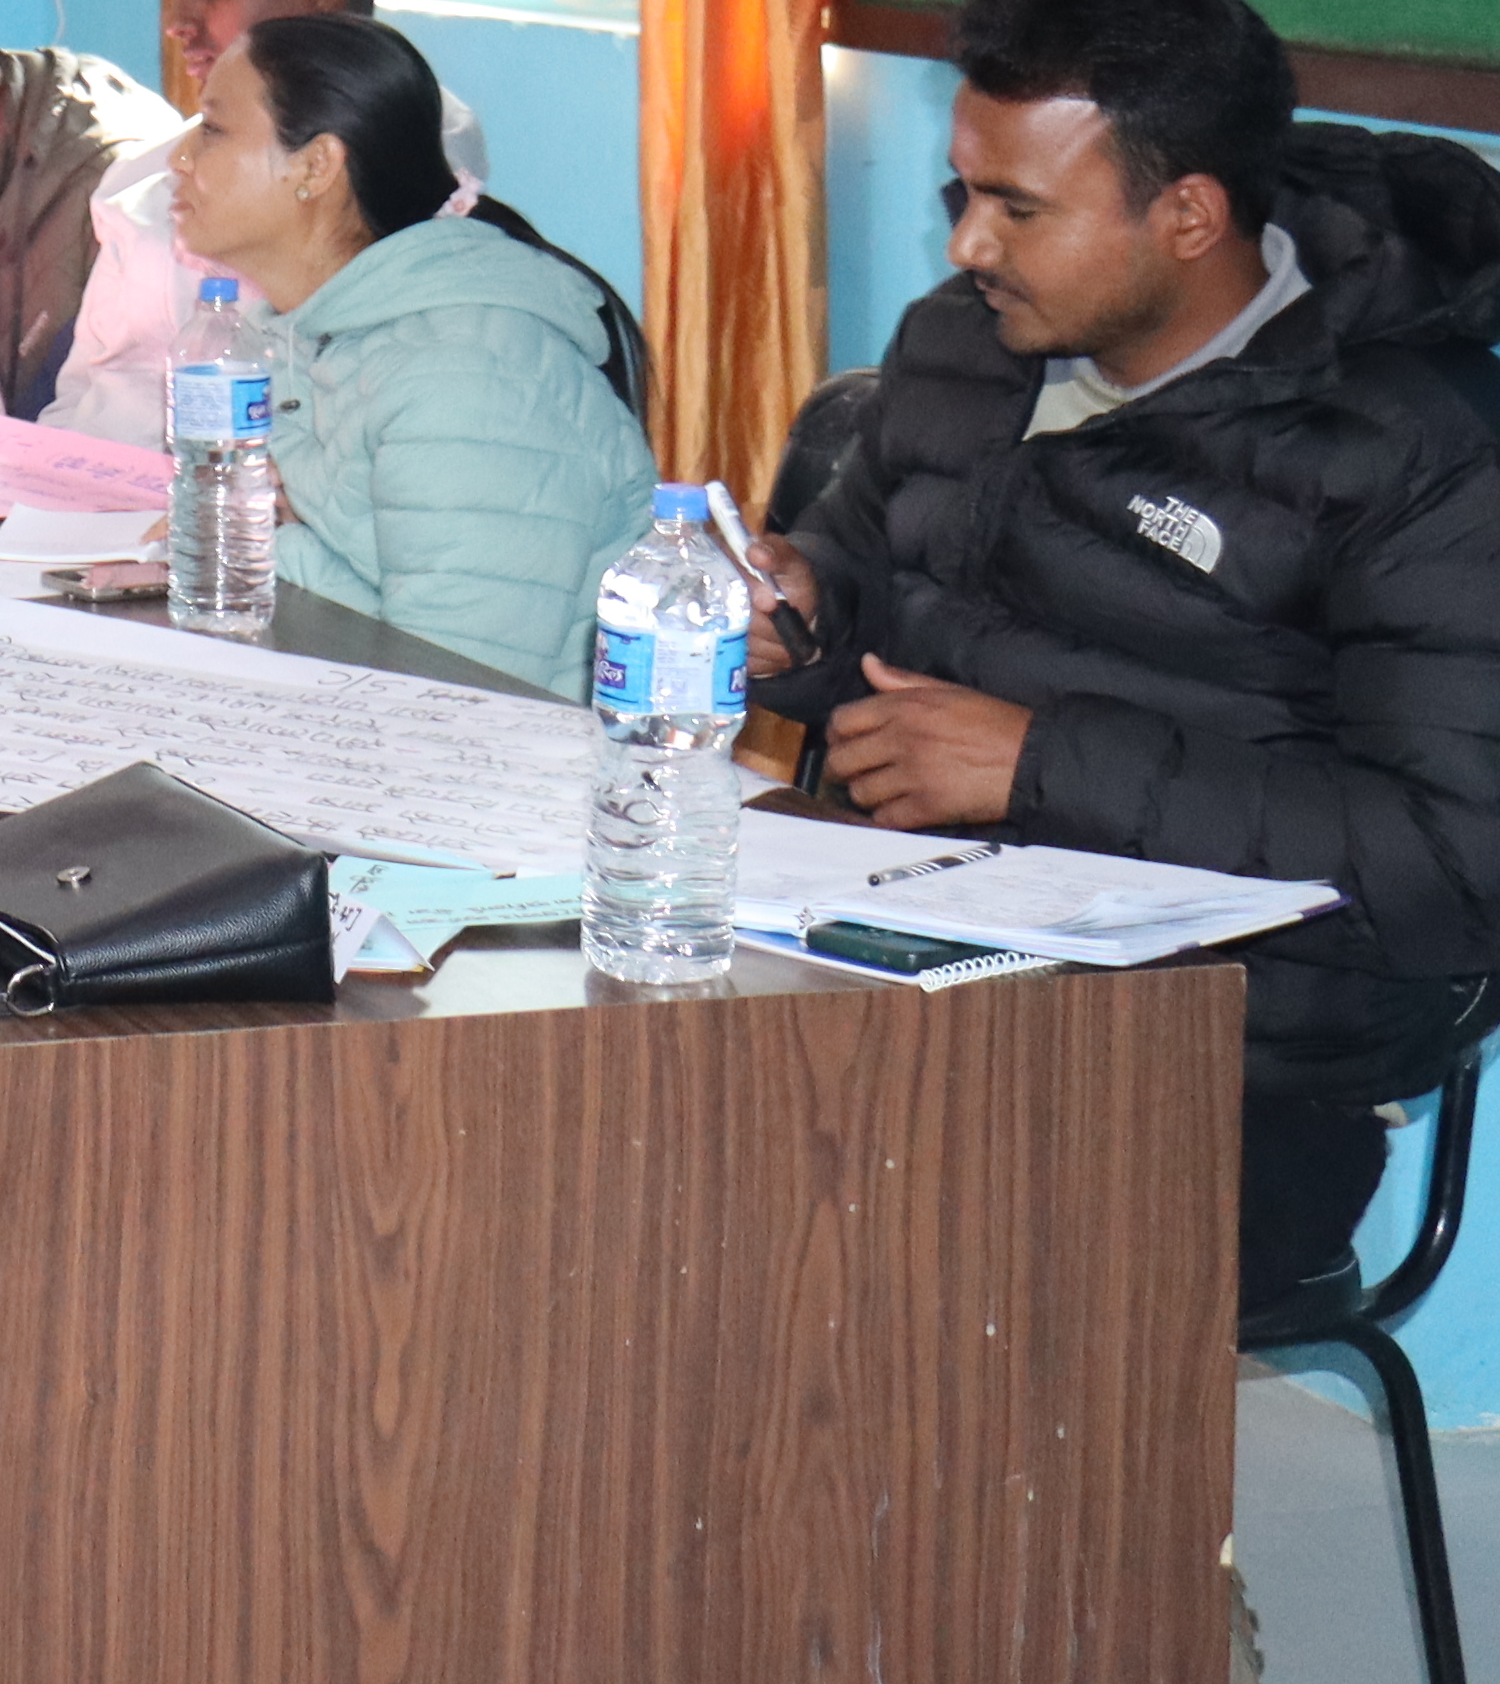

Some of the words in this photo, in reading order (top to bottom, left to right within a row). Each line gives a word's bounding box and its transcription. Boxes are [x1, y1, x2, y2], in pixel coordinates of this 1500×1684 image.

[1126, 493, 1193, 540] NORTH
[1165, 495, 1200, 526] THE
[1136, 518, 1184, 554] FACE
